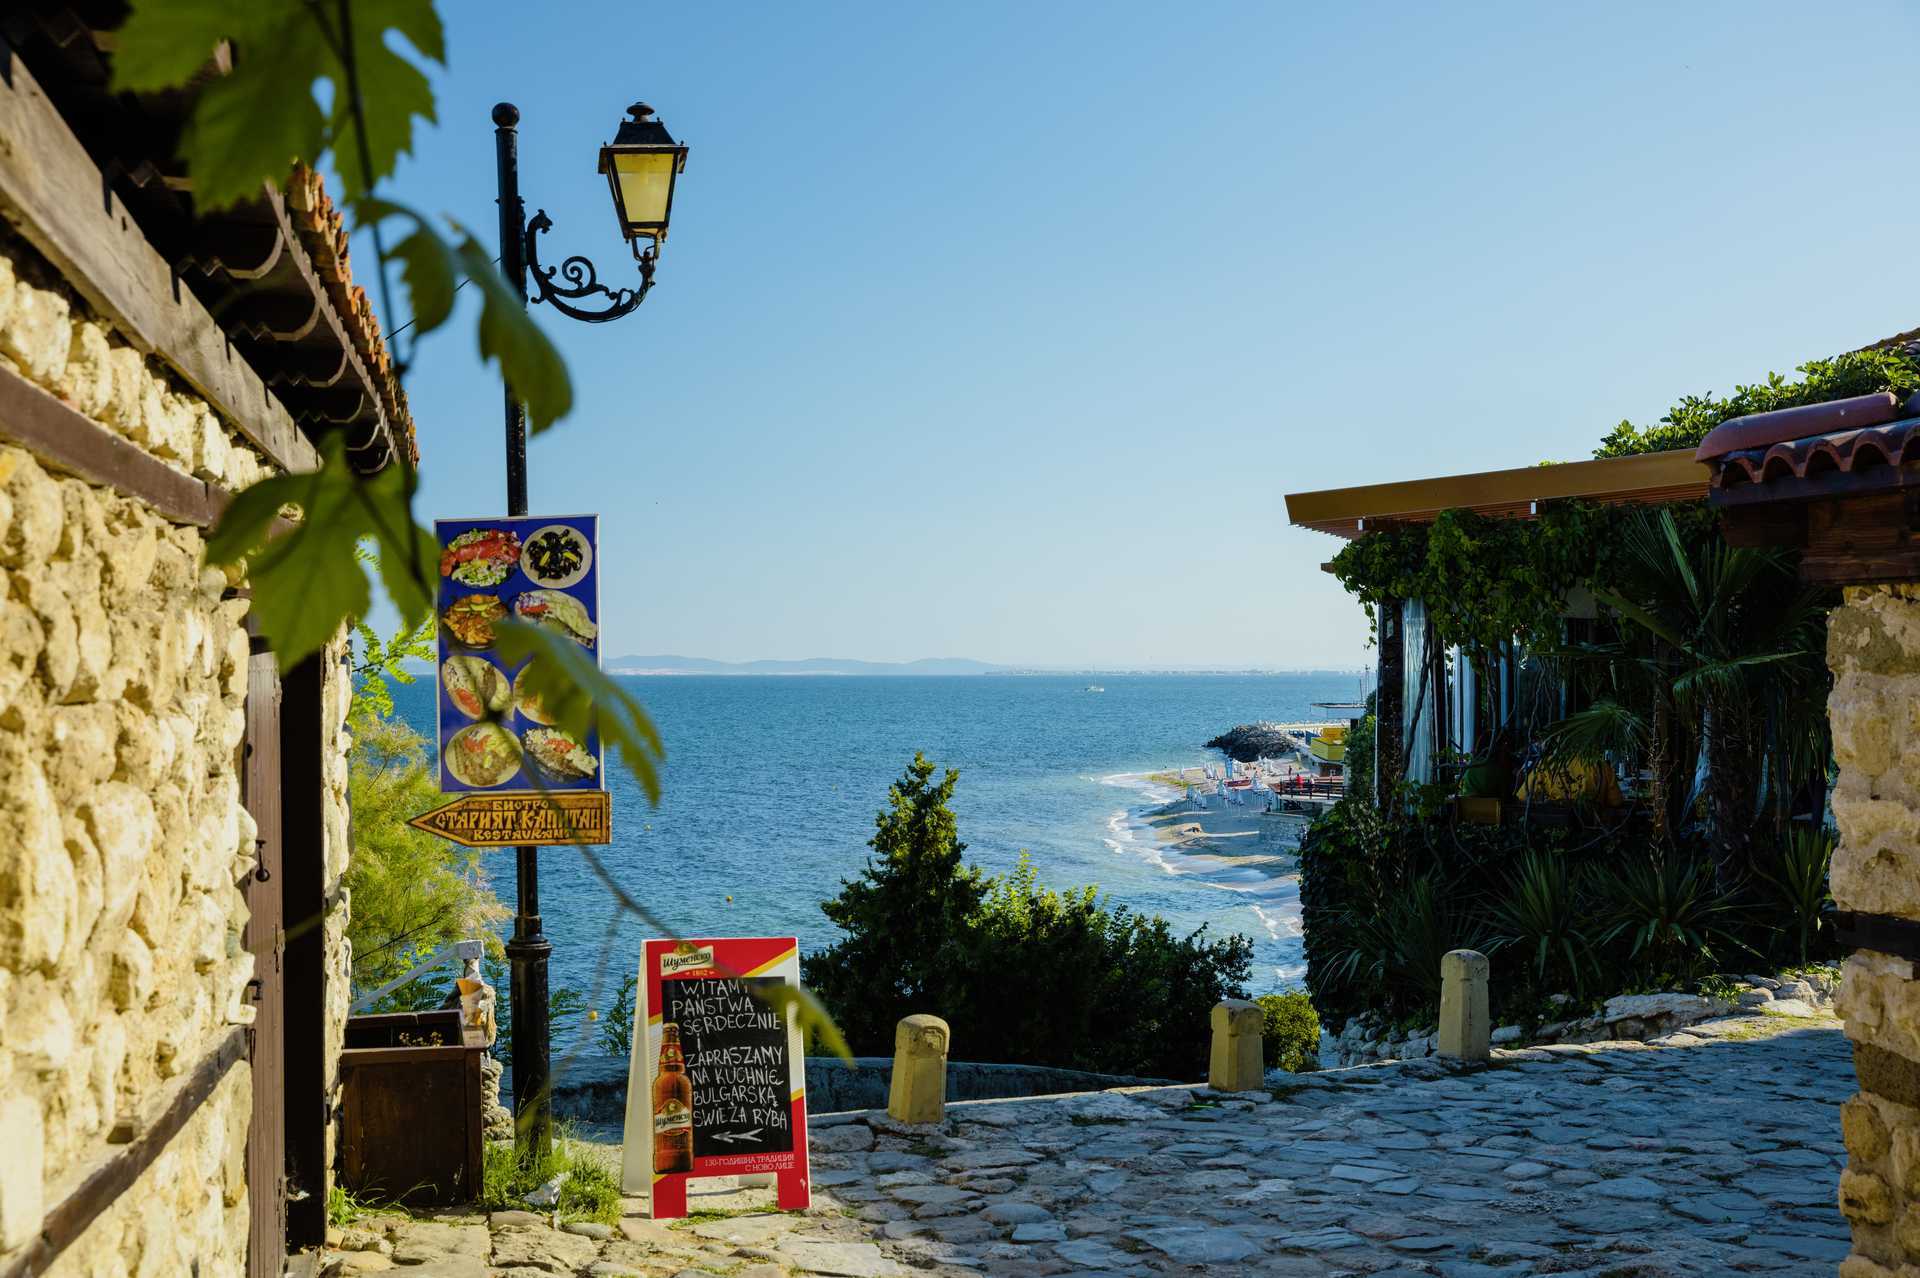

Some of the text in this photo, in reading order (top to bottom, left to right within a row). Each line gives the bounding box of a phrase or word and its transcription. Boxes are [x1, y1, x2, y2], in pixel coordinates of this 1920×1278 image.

[492, 800, 549, 811] БИСТРО
[435, 811, 517, 830] СТАРИЯТ
[682, 1006, 782, 1036] SERDECZNIE
[684, 1045, 784, 1068] ZAPRASZAMY
[692, 1066, 711, 1086] NA
[752, 1107, 788, 1131] RYBA
